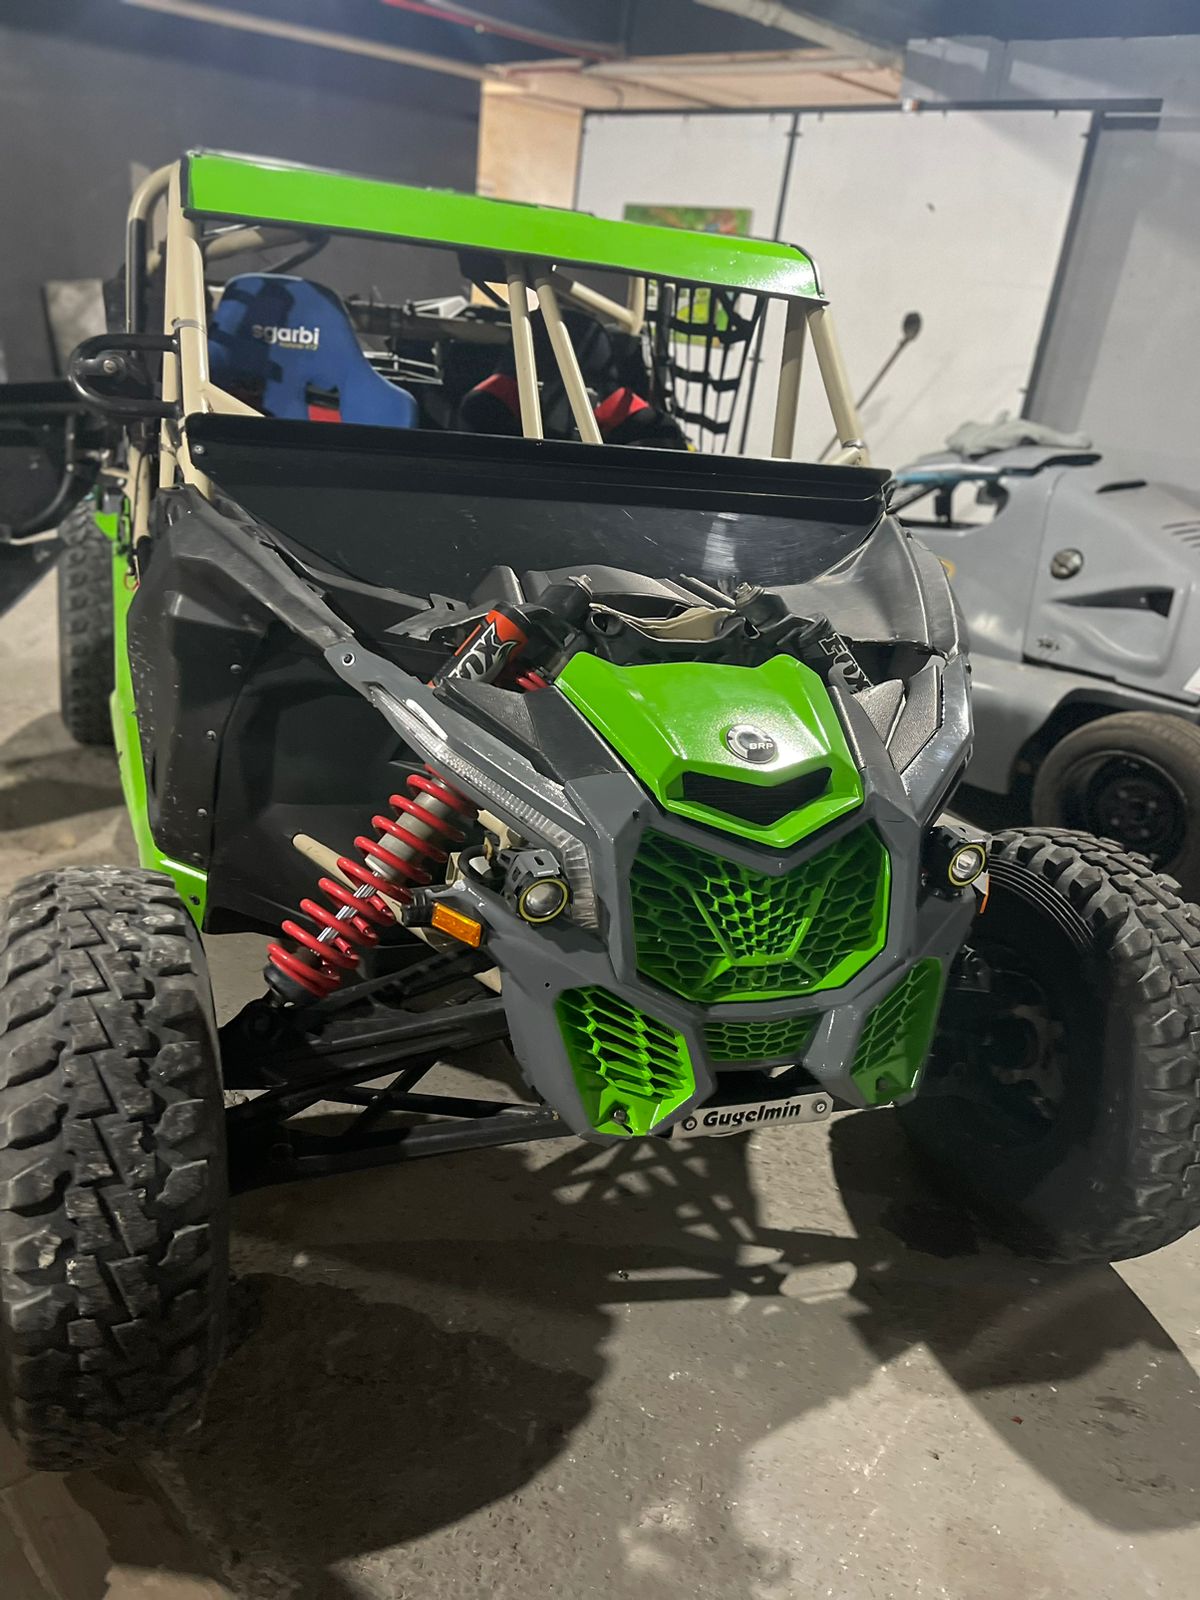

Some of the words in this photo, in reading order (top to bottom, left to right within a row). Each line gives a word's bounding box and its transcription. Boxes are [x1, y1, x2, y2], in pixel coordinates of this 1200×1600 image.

[252, 324, 319, 344] sgarbi
[749, 742, 774, 750] BRP
[703, 1101, 801, 1127] Gugelmin
